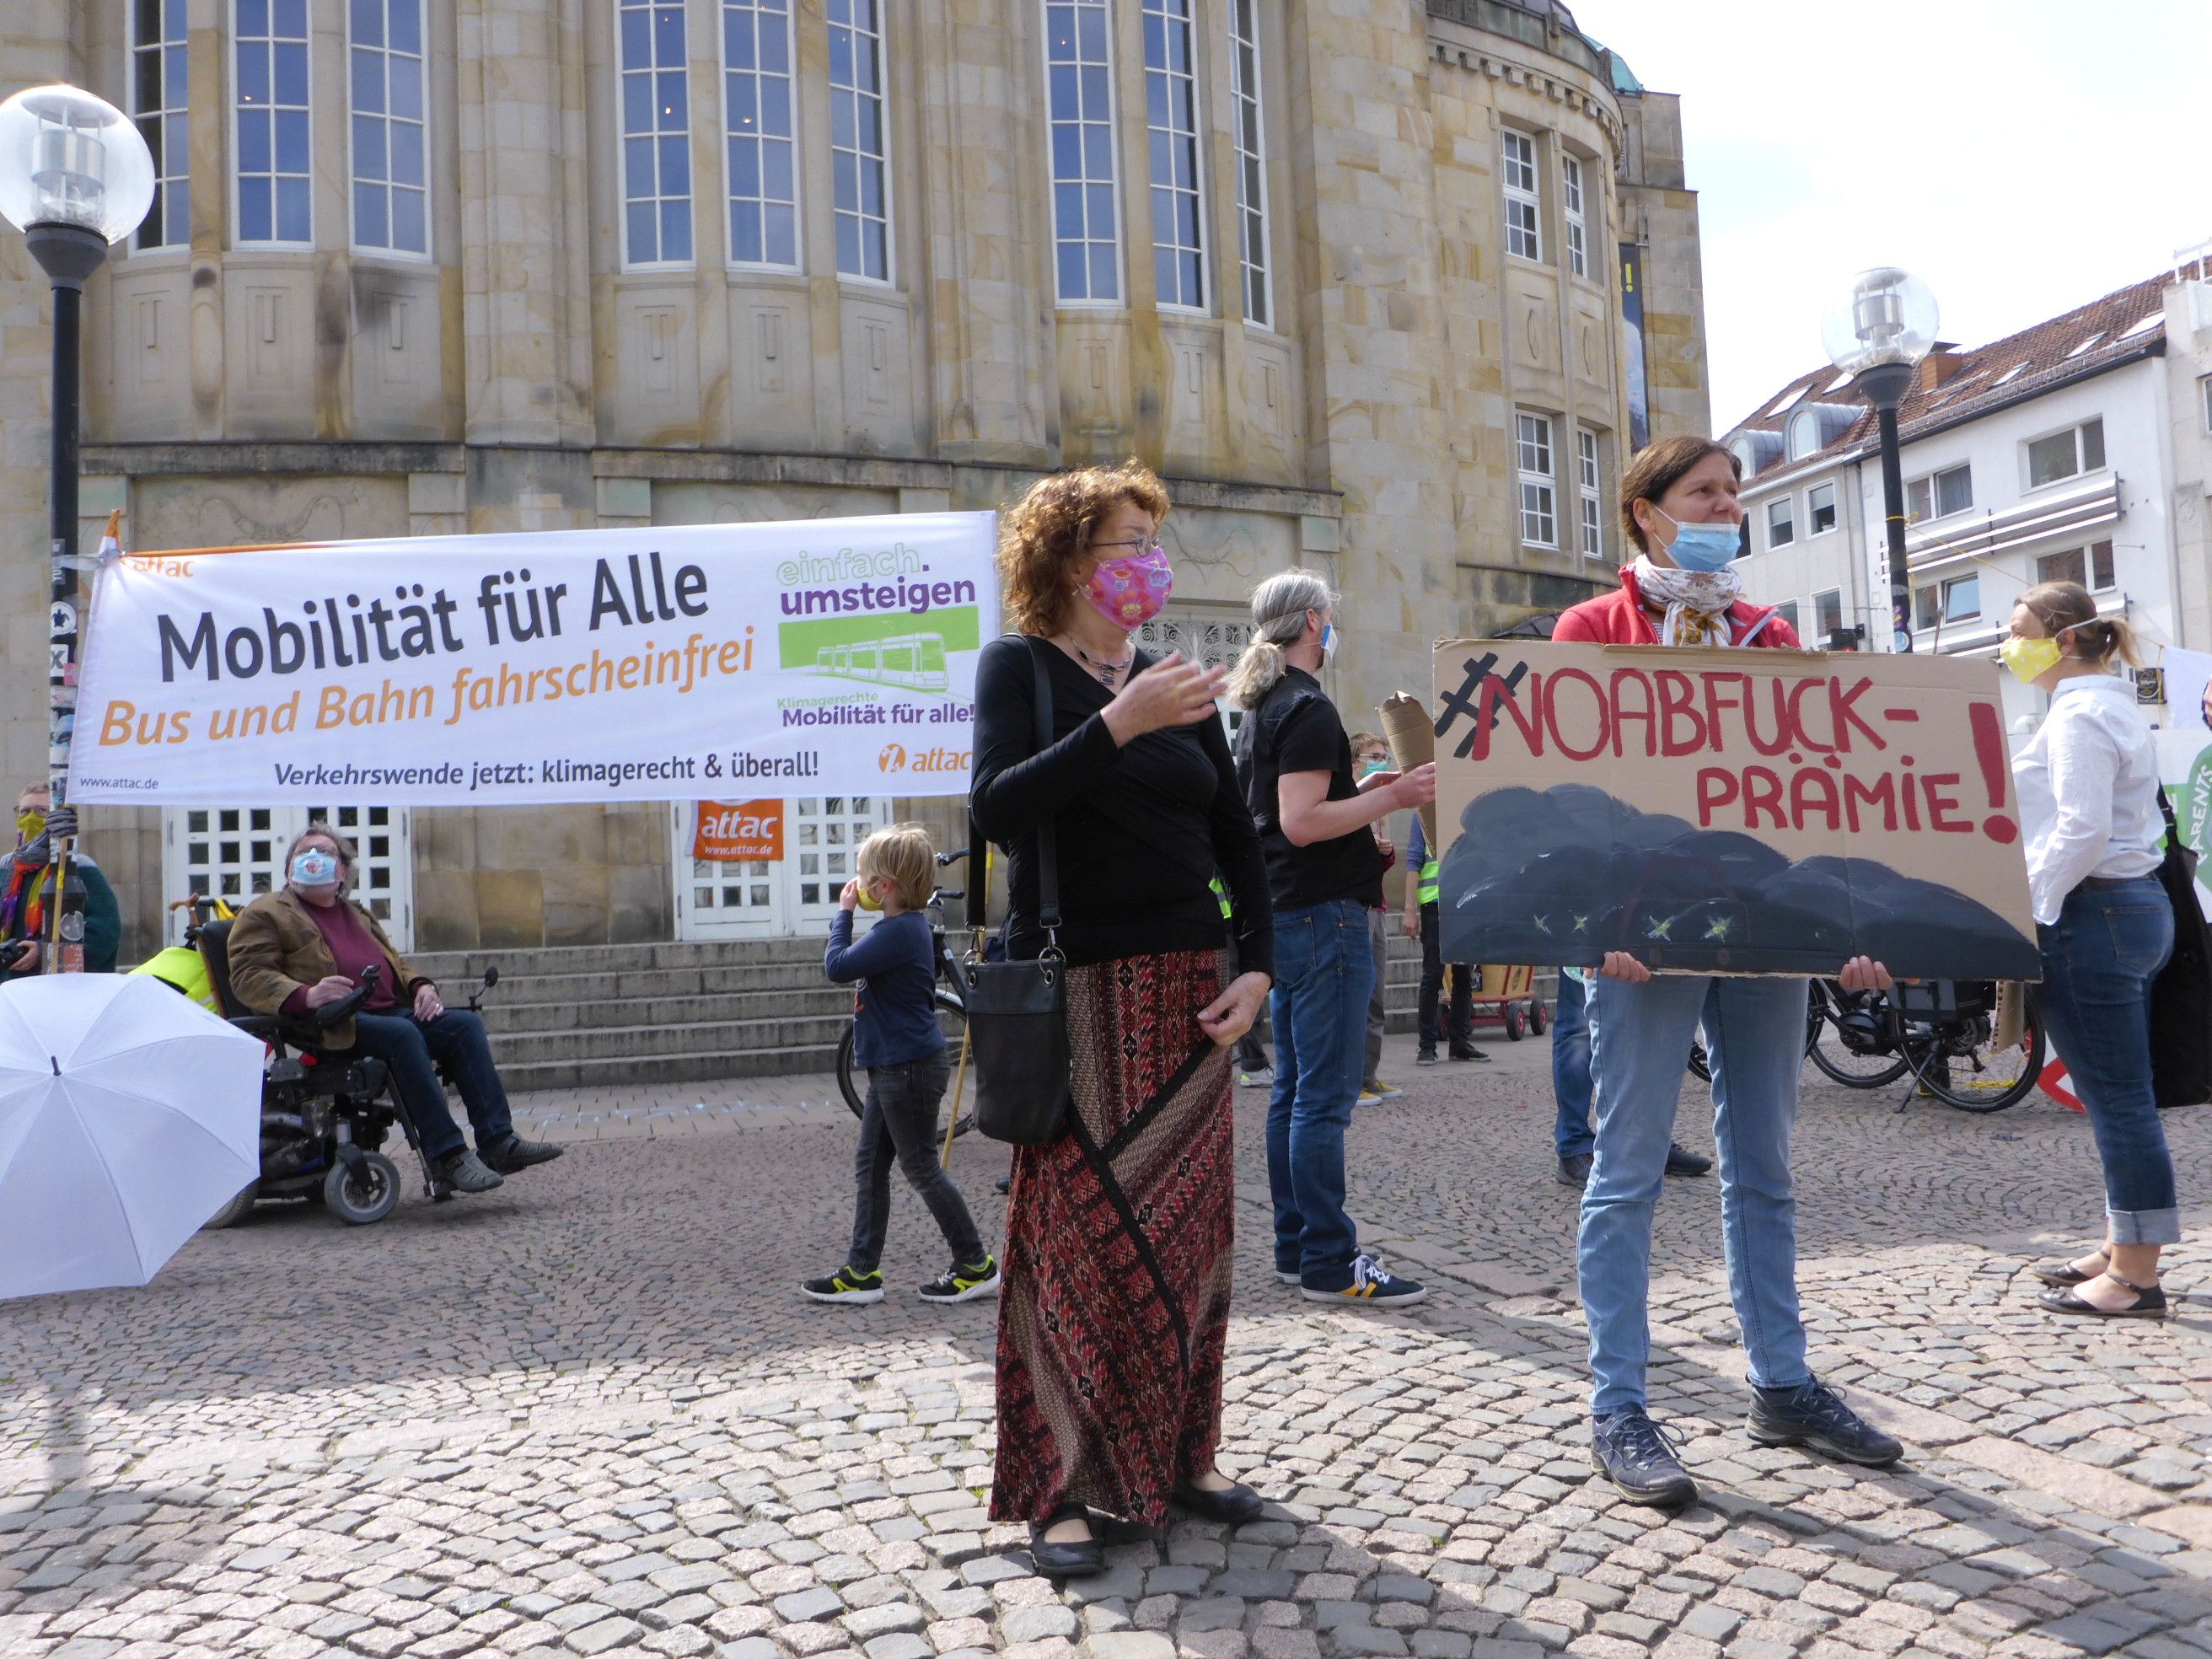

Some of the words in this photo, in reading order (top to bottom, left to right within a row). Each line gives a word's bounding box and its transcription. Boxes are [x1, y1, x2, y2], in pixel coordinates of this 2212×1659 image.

[776, 543, 930, 586] einfach.
[781, 576, 975, 614] umsteigen
[158, 583, 464, 682] Mobilität
[477, 568, 567, 645] für
[589, 551, 709, 631] Alle
[99, 701, 191, 746] Bus
[208, 690, 300, 740] und
[315, 679, 433, 729] Bahn
[444, 625, 754, 725] fahrscheinfrei
[777, 692, 879, 710] Klimagerechte
[782, 704, 886, 727] Mobilität
[891, 703, 925, 723] für
[929, 702, 975, 723] alle!
[274, 762, 463, 786] Verkehrswende
[470, 760, 534, 791] jetzt:
[541, 756, 695, 787] klimagerecht
[704, 754, 723, 778] &
[731, 752, 819, 777] überall!
[911, 747, 974, 773] attac
[79, 776, 159, 791] www.attac.de
[701, 811, 777, 839] attac
[705, 845, 773, 855] www.attac.de
